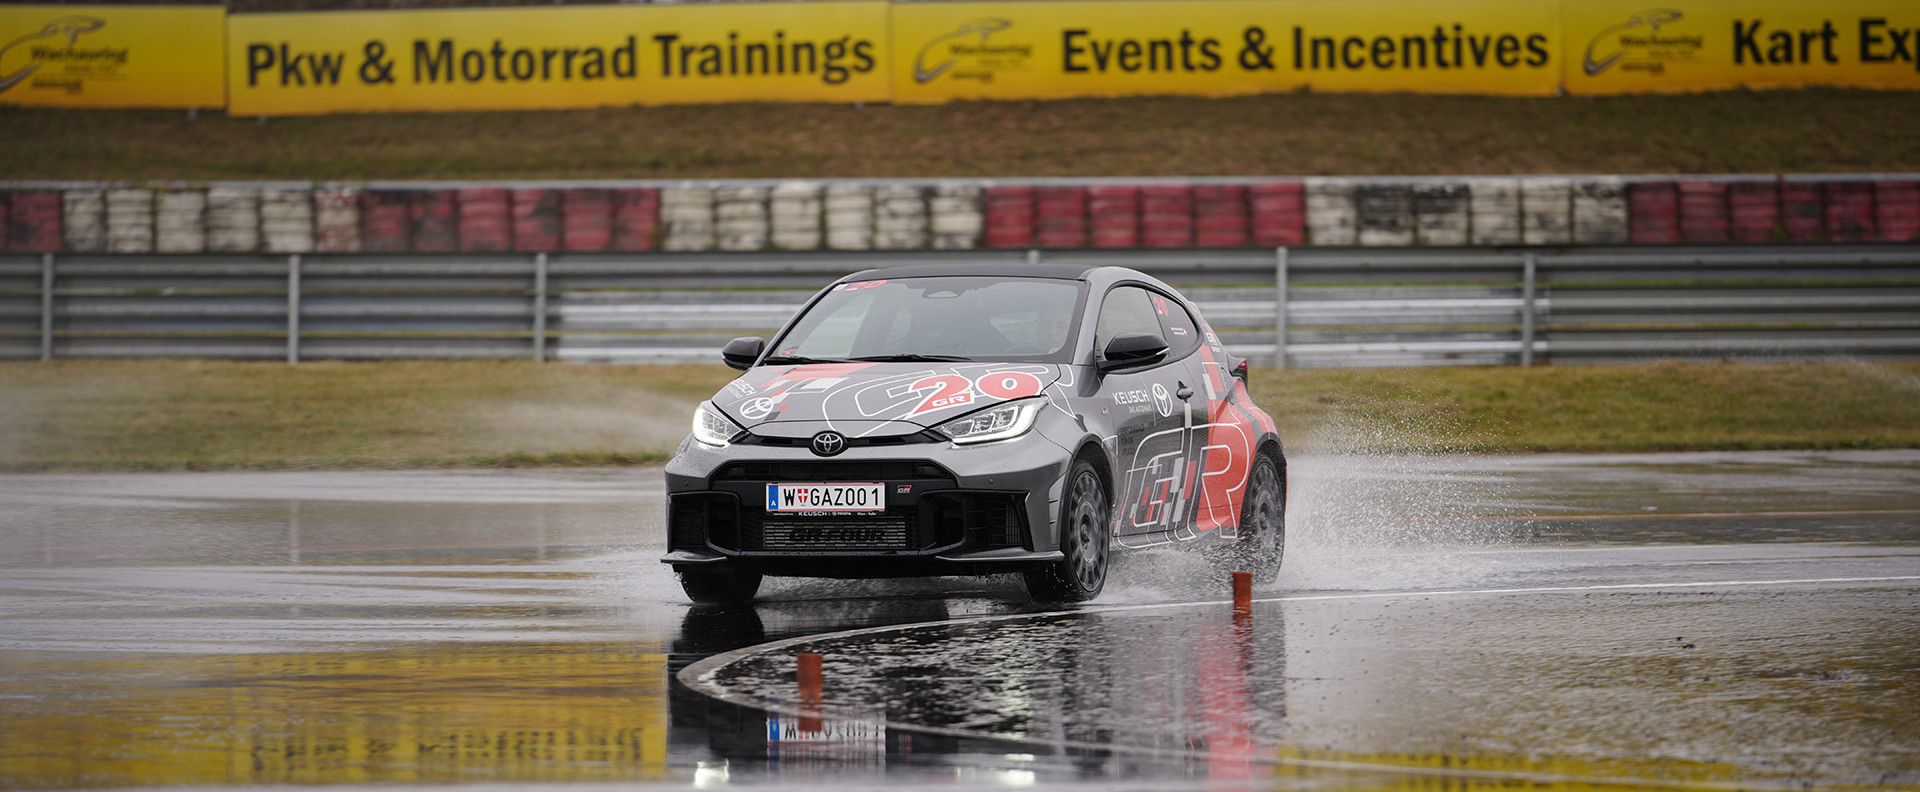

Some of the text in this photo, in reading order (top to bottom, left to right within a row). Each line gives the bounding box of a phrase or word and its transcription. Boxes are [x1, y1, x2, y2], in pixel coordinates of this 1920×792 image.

[248, 32, 874, 86] Pkw & Motorrad Trainings
[1064, 25, 1548, 72] Events & Incentives
[1733, 17, 1920, 74] Kart Ex
[1153, 295, 1169, 317] 20
[902, 370, 1043, 420] 20
[931, 394, 966, 407] GR
[1112, 390, 1151, 405] KEUSCH
[783, 488, 796, 507] W
